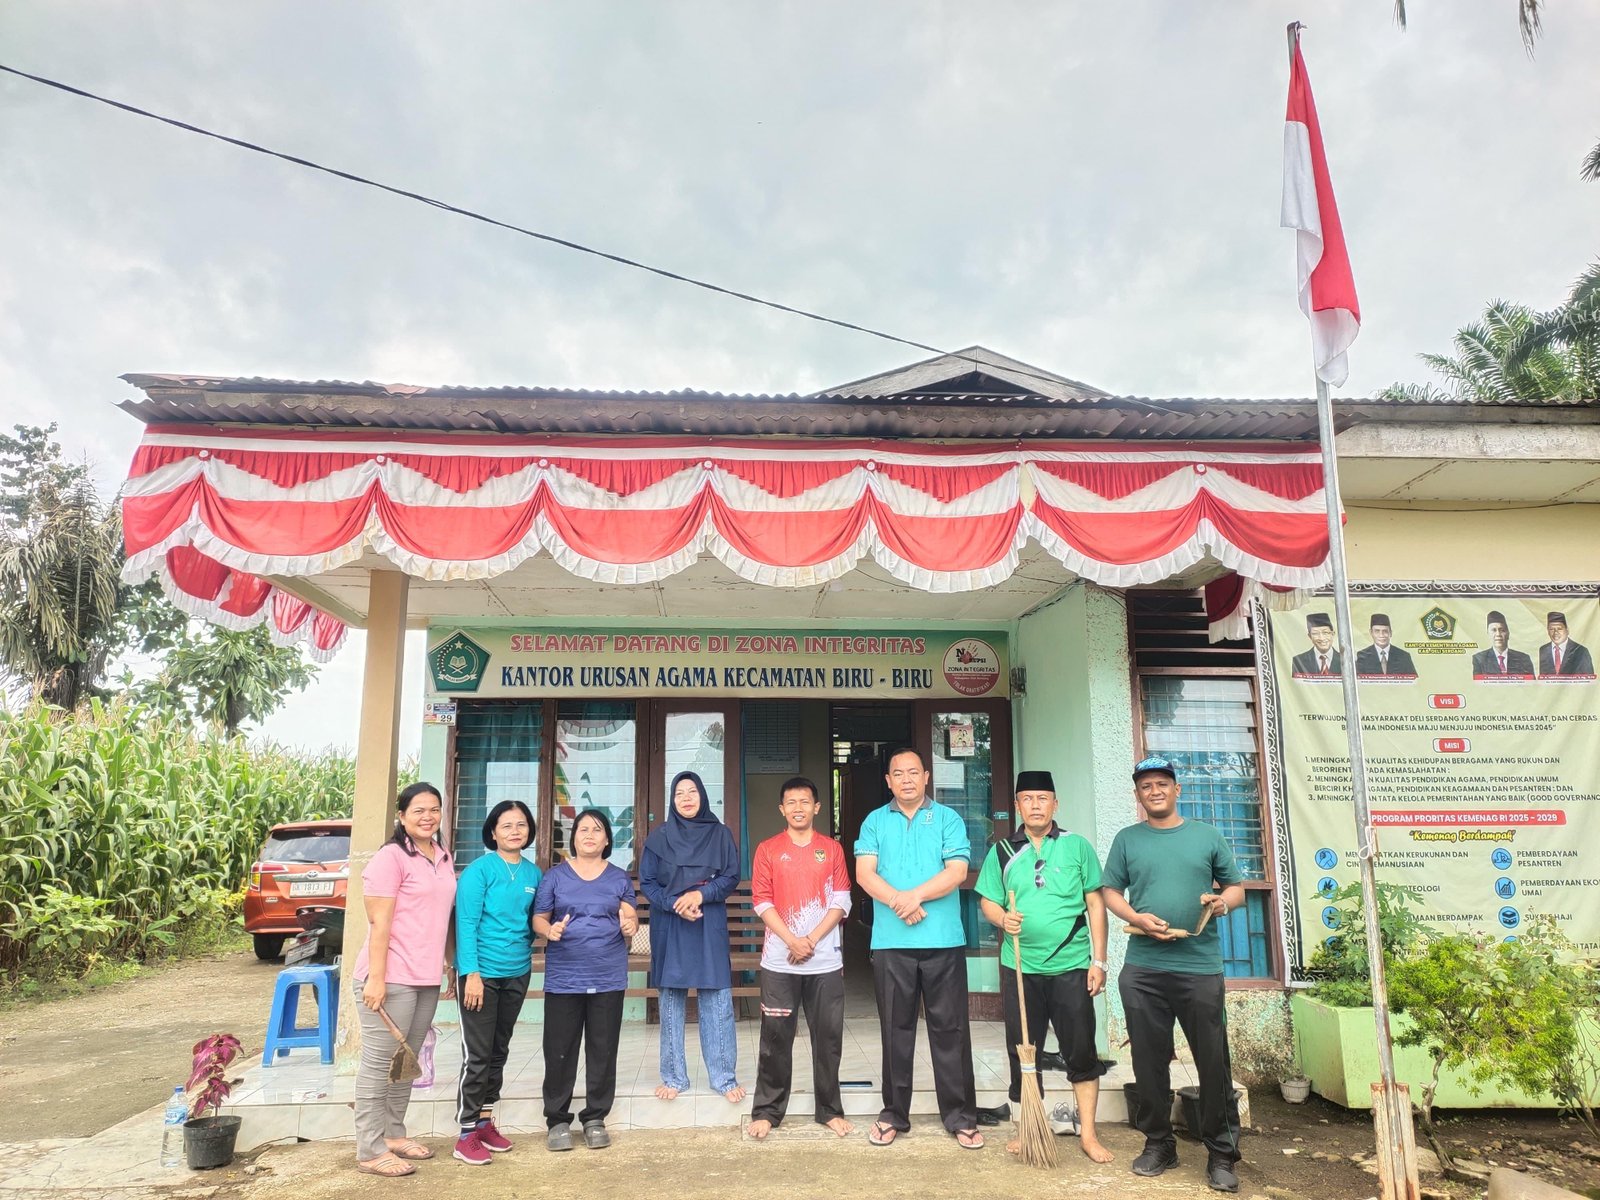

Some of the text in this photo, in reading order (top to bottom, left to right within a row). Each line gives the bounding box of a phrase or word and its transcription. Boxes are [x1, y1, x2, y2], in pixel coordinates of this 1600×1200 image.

[509, 633, 926, 655] SELAMAT DATANG DI ZONA INTEGRITAS
[501, 666, 574, 687] KANTOR
[580, 666, 650, 687] URUSAN
[655, 667, 718, 687] AGAMA
[724, 667, 826, 688] KECAMATAN
[832, 668, 873, 688] BIRU
[892, 668, 933, 689] BIRU
[440, 714, 452, 723] 29
[1458, 776, 1488, 784] AGAMA,
[1527, 793, 1553, 802] (GOOD
[1372, 814, 1413, 823] PROGRAM
[1415, 814, 1456, 823] PRORITAS
[1457, 814, 1499, 822] KEMENAG
[1500, 814, 1508, 822] RI
[1509, 814, 1529, 822] 2025
[1537, 813, 1557, 822] 2029
[1516, 850, 1578, 858] PEMBERDAYAAN
[1520, 879, 1582, 887] PEMBERDAYAAN
